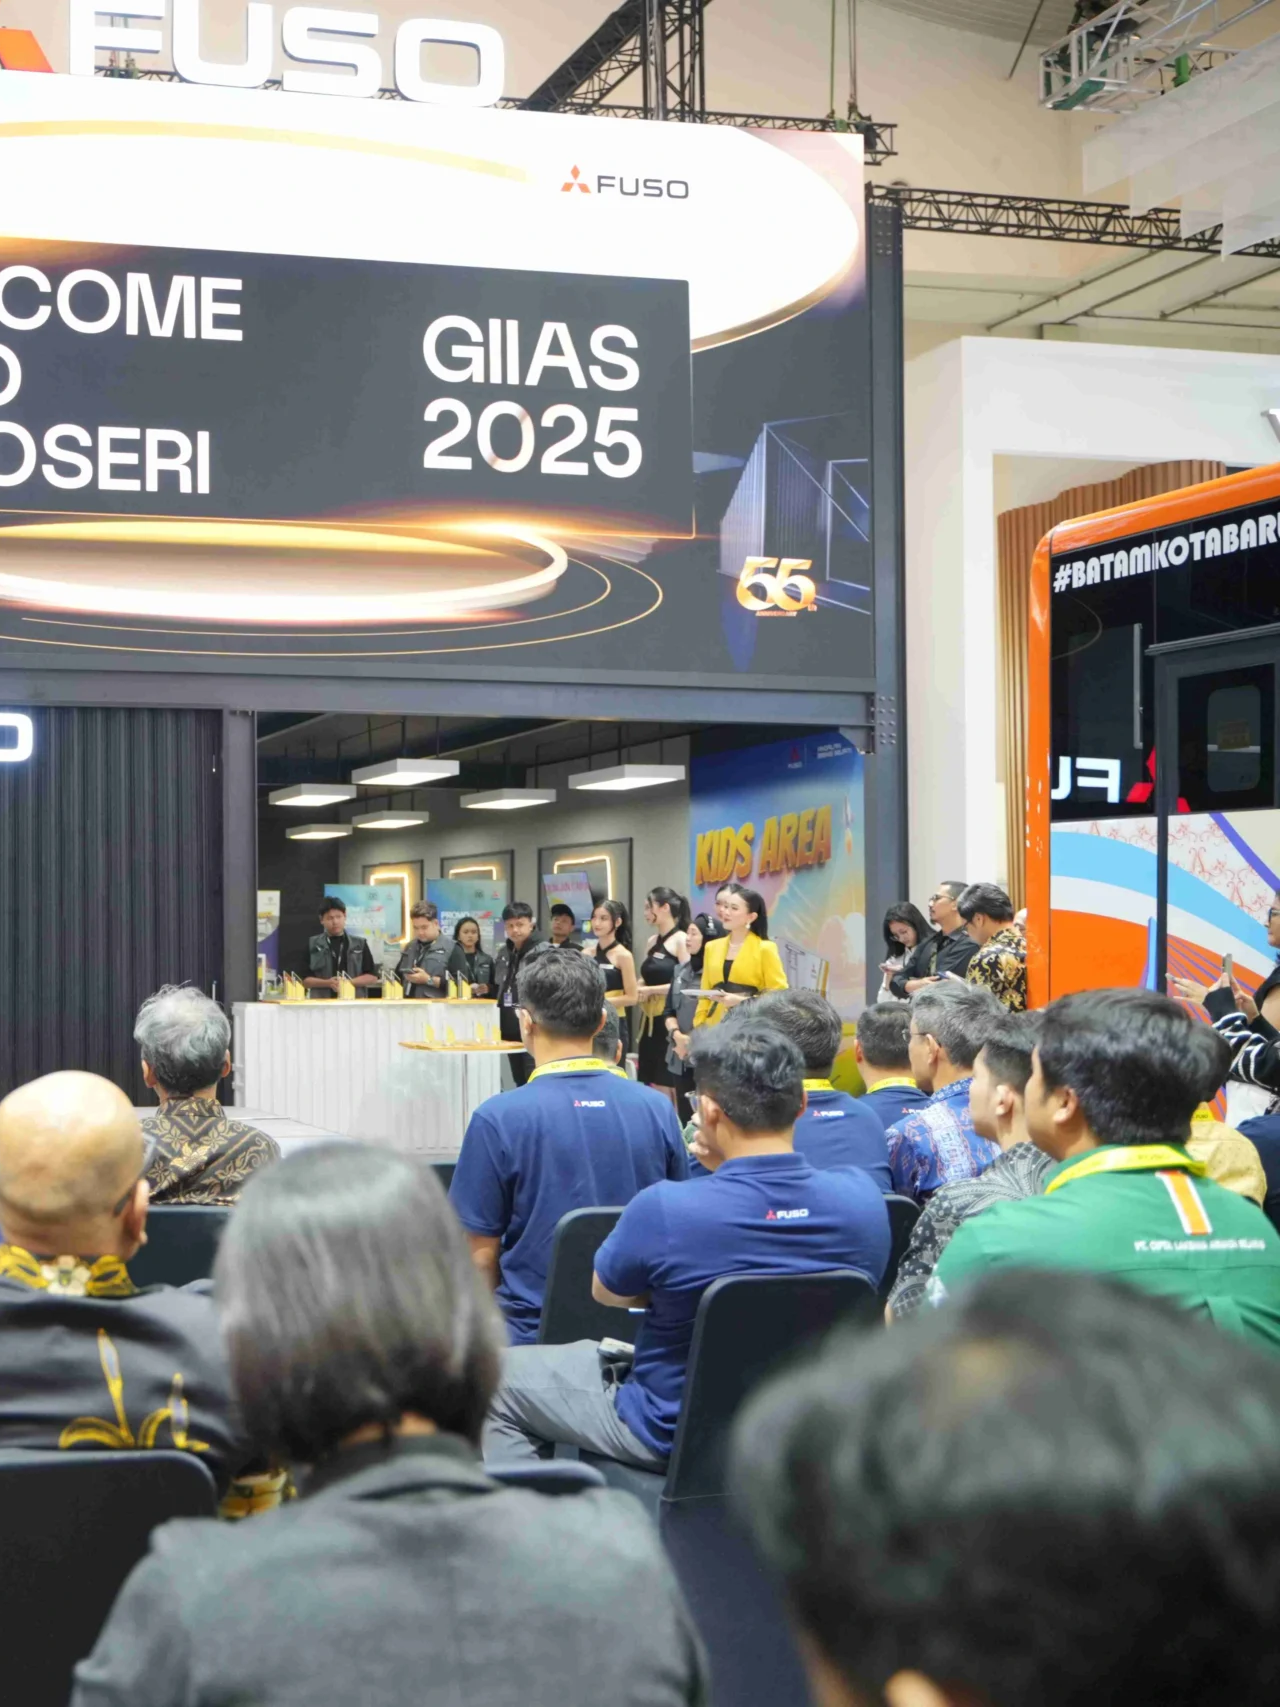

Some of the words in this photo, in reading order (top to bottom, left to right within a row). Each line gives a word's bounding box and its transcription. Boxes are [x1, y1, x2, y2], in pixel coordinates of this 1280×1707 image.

[68, 0, 505, 107] FUSO
[596, 175, 689, 199] FUSO
[422, 315, 640, 392] GIIAS
[423, 397, 643, 478] 2025
[1053, 511, 1280, 593] #BATAMKOTABAR
[694, 821, 755, 886] KIDS
[758, 803, 833, 876] AREA
[776, 1208, 810, 1220] FUSO
